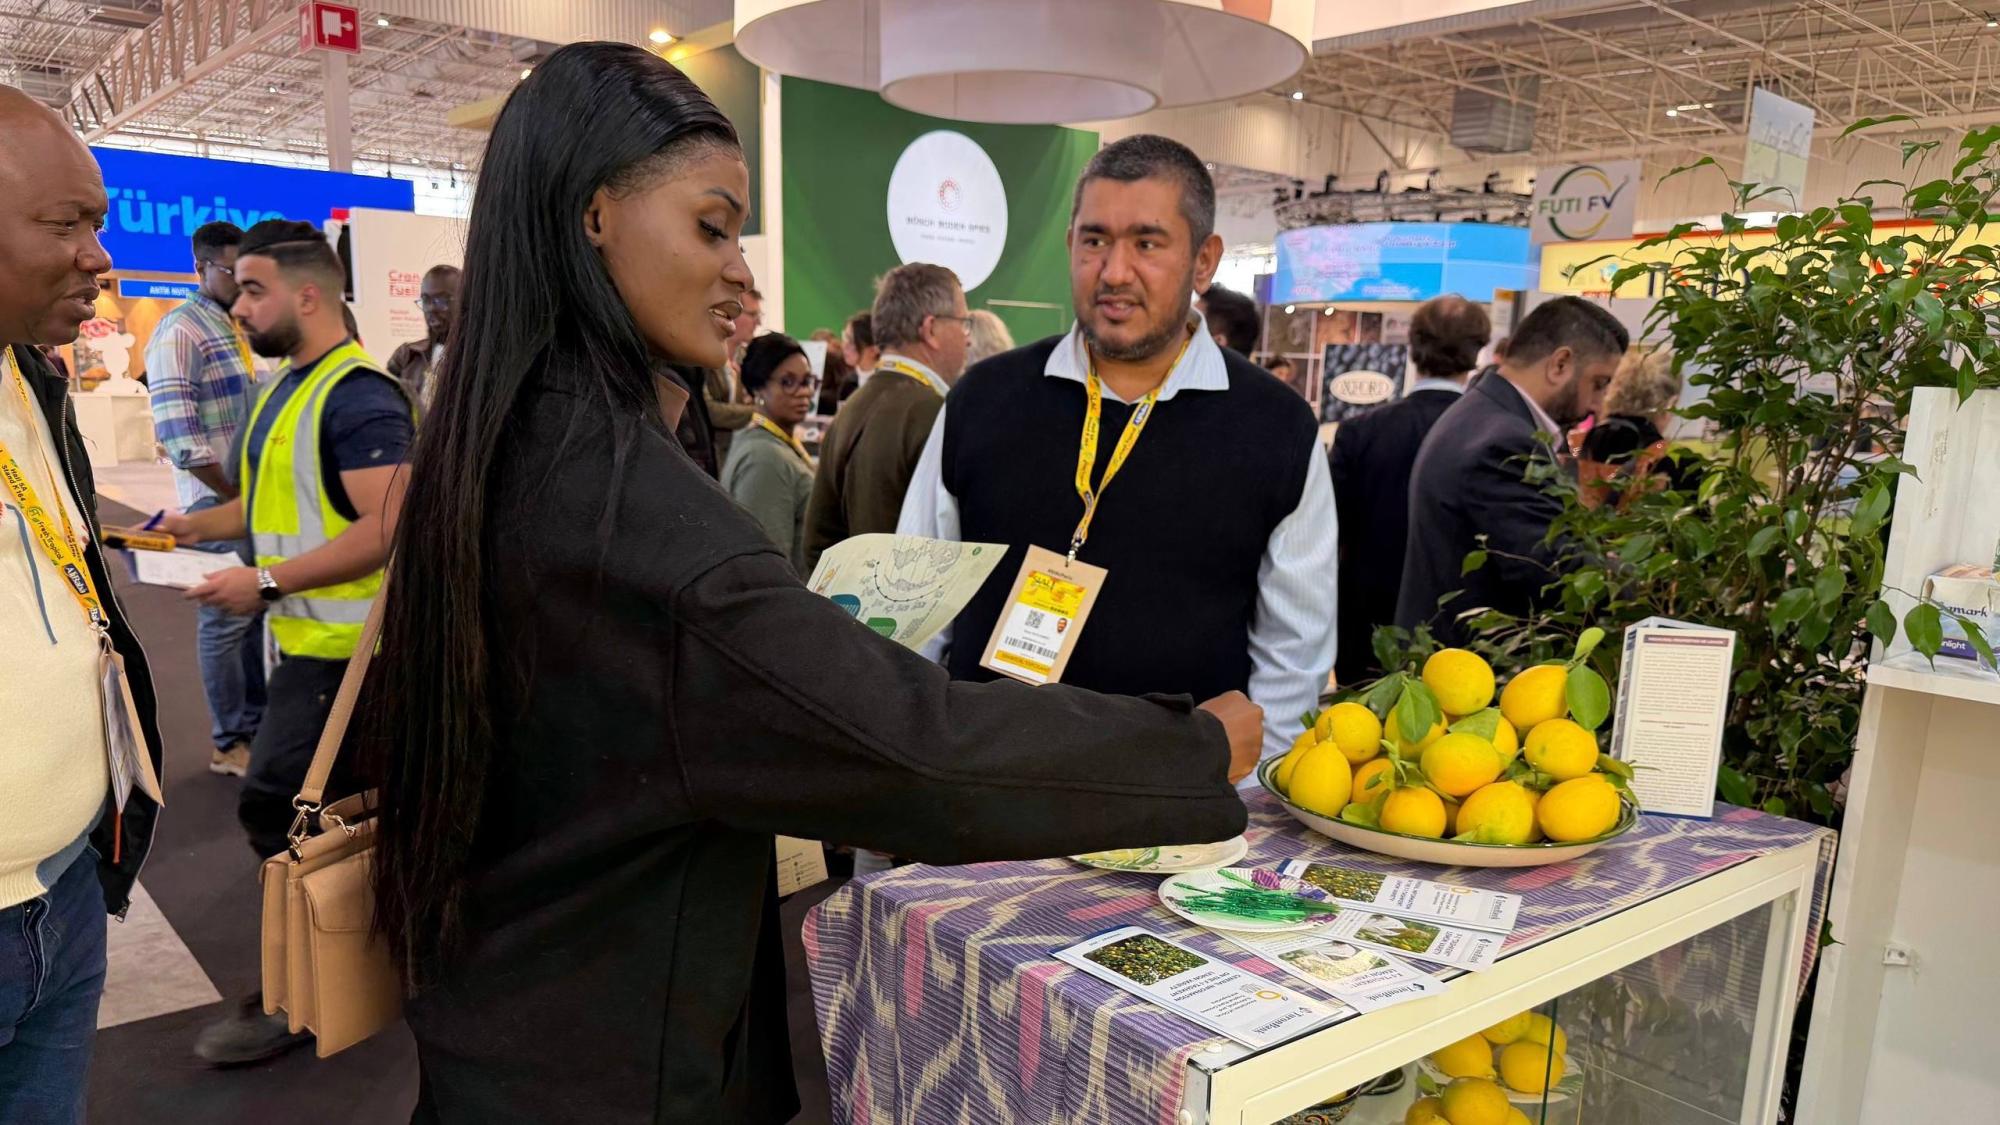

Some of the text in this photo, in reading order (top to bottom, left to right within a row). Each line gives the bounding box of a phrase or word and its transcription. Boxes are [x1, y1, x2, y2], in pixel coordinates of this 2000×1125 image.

[1538, 198, 1580, 215] FUTI
[1, 463, 15, 484] Stand
[12, 483, 19, 491] K
[10, 467, 22, 482] Hall
